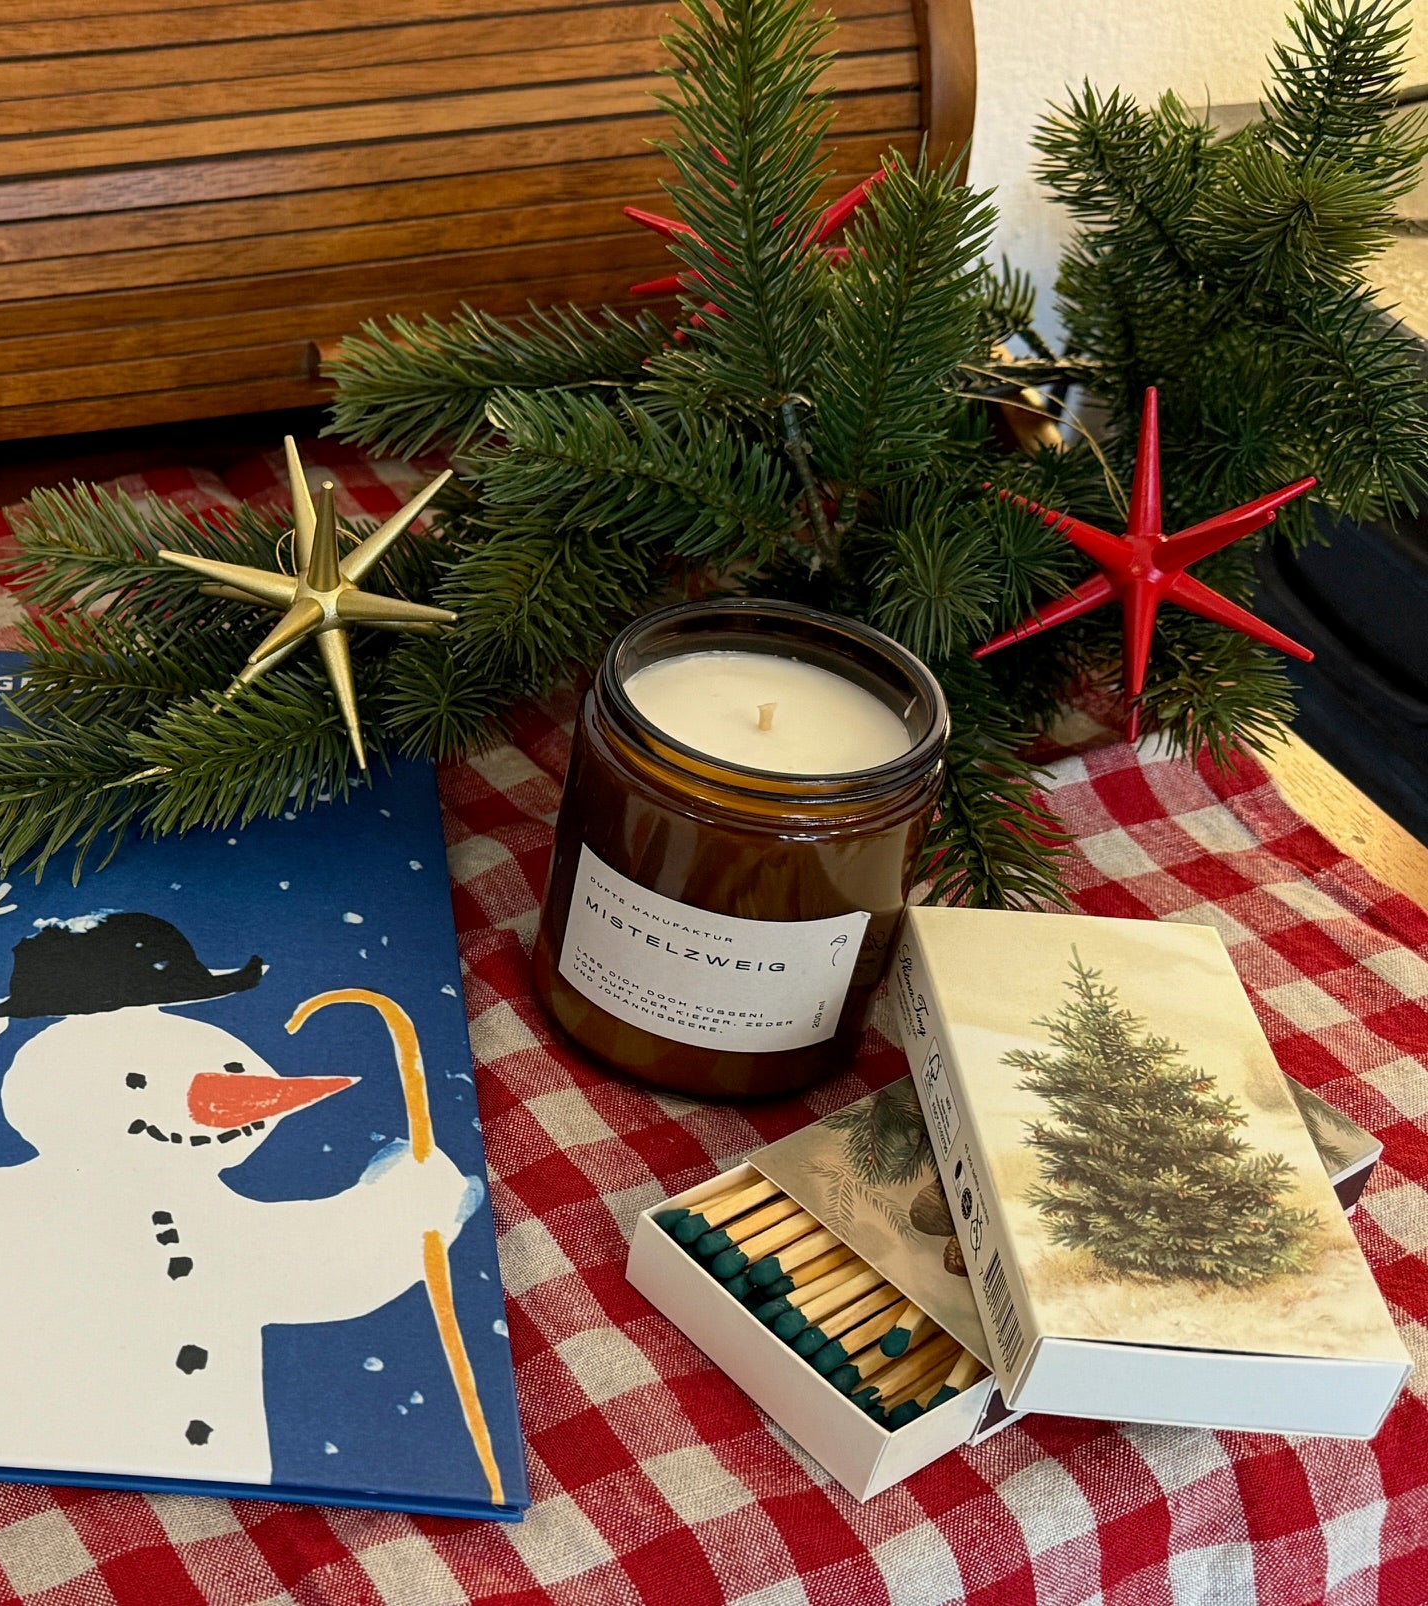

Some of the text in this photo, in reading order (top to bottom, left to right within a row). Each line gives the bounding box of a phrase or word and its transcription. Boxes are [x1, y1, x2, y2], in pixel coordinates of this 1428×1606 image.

[590, 876, 733, 943] DUFTE MANUFAKTUR
[585, 895, 786, 973] MISTELZWEIG
[573, 963, 593, 982] UND
[575, 955, 595, 974] VOM
[601, 976, 633, 995] DUFT
[640, 997, 667, 1011] DER
[609, 970, 639, 989] DICH
[647, 990, 687, 1006] DOCH
[812, 1000, 826, 1028] 200 ml
